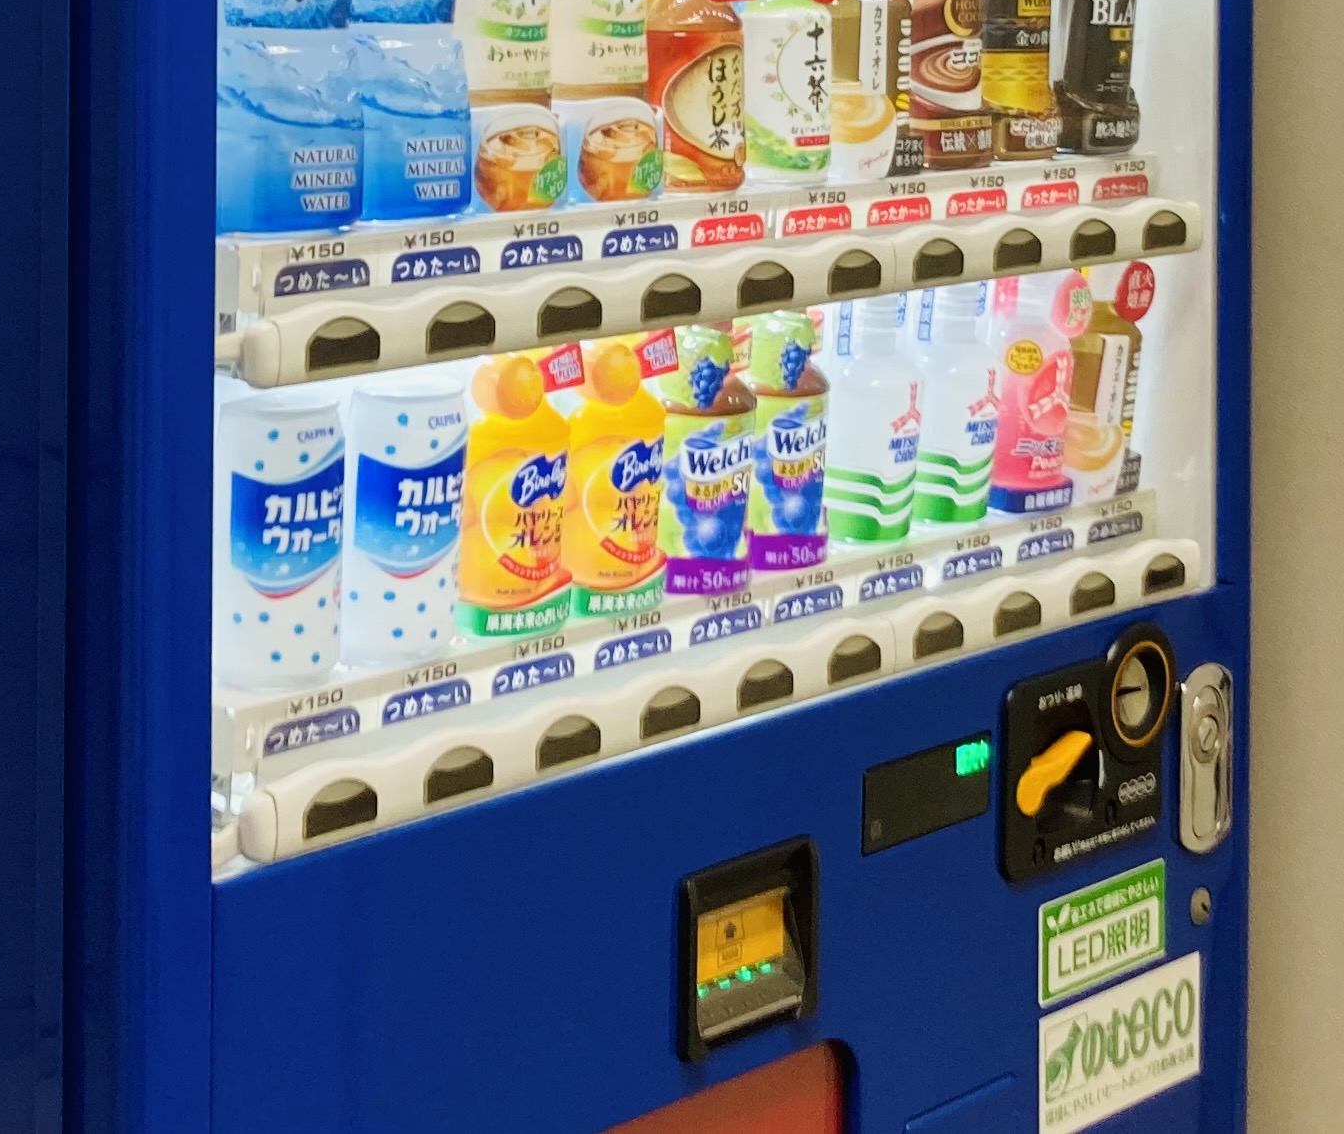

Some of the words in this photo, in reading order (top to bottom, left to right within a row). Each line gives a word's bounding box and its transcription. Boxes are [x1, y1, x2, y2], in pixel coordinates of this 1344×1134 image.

[805, 22, 829, 113] 十六茶
[708, 56, 730, 151] ほうじ茶
[406, 137, 465, 154] NATURAL
[293, 147, 357, 165] NATURAL
[407, 161, 465, 177] MINERAL
[1043, 167, 1076, 181] ¥150
[293, 171, 356, 188] MINERAL
[889, 182, 926, 195] ¥150
[970, 176, 1005, 189] ¥150
[415, 183, 460, 198] WATER
[808, 191, 846, 205] ¥150
[302, 194, 350, 210] WATER
[708, 199, 749, 215] ¥150
[615, 210, 659, 227] ¥150
[513, 221, 560, 238] ¥150
[404, 230, 455, 249] ¥150
[291, 242, 345, 261] ¥150
[876, 552, 914, 571] ¥150
[794, 570, 834, 589] ¥150
[710, 591, 752, 612] ¥150
[617, 611, 661, 633] ¥150
[517, 636, 565, 657] ¥150
[406, 662, 457, 686] ¥150
[289, 688, 344, 715] ¥150
[1058, 908, 1150, 978] LED照明
